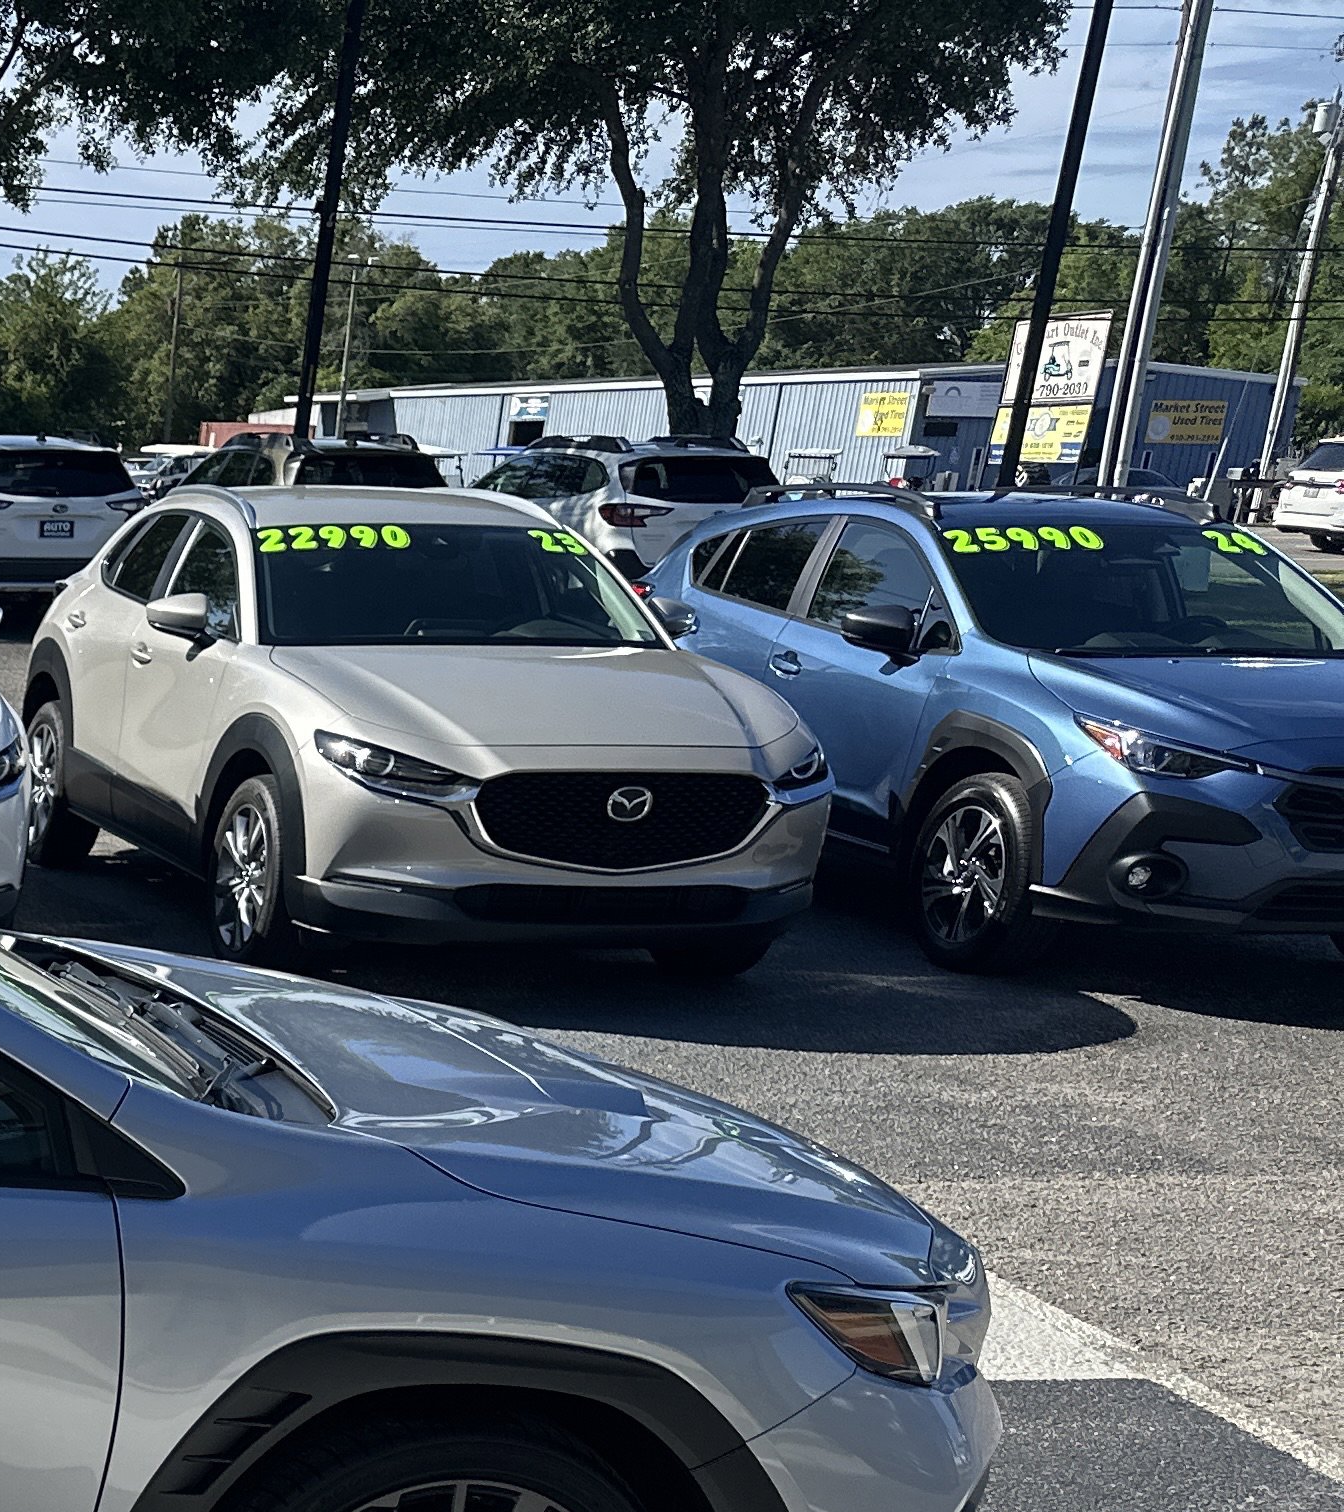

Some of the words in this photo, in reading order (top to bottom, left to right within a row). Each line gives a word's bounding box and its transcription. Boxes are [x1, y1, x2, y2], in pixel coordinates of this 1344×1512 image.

[1152, 402, 1190, 414] Market
[1193, 403, 1226, 414] Street
[1172, 416, 1197, 425] Used
[1199, 416, 1222, 425] Tires
[44, 522, 71, 532] AUTO
[257, 525, 411, 553] 22990
[527, 529, 589, 556] 23
[942, 525, 1104, 553] 25990
